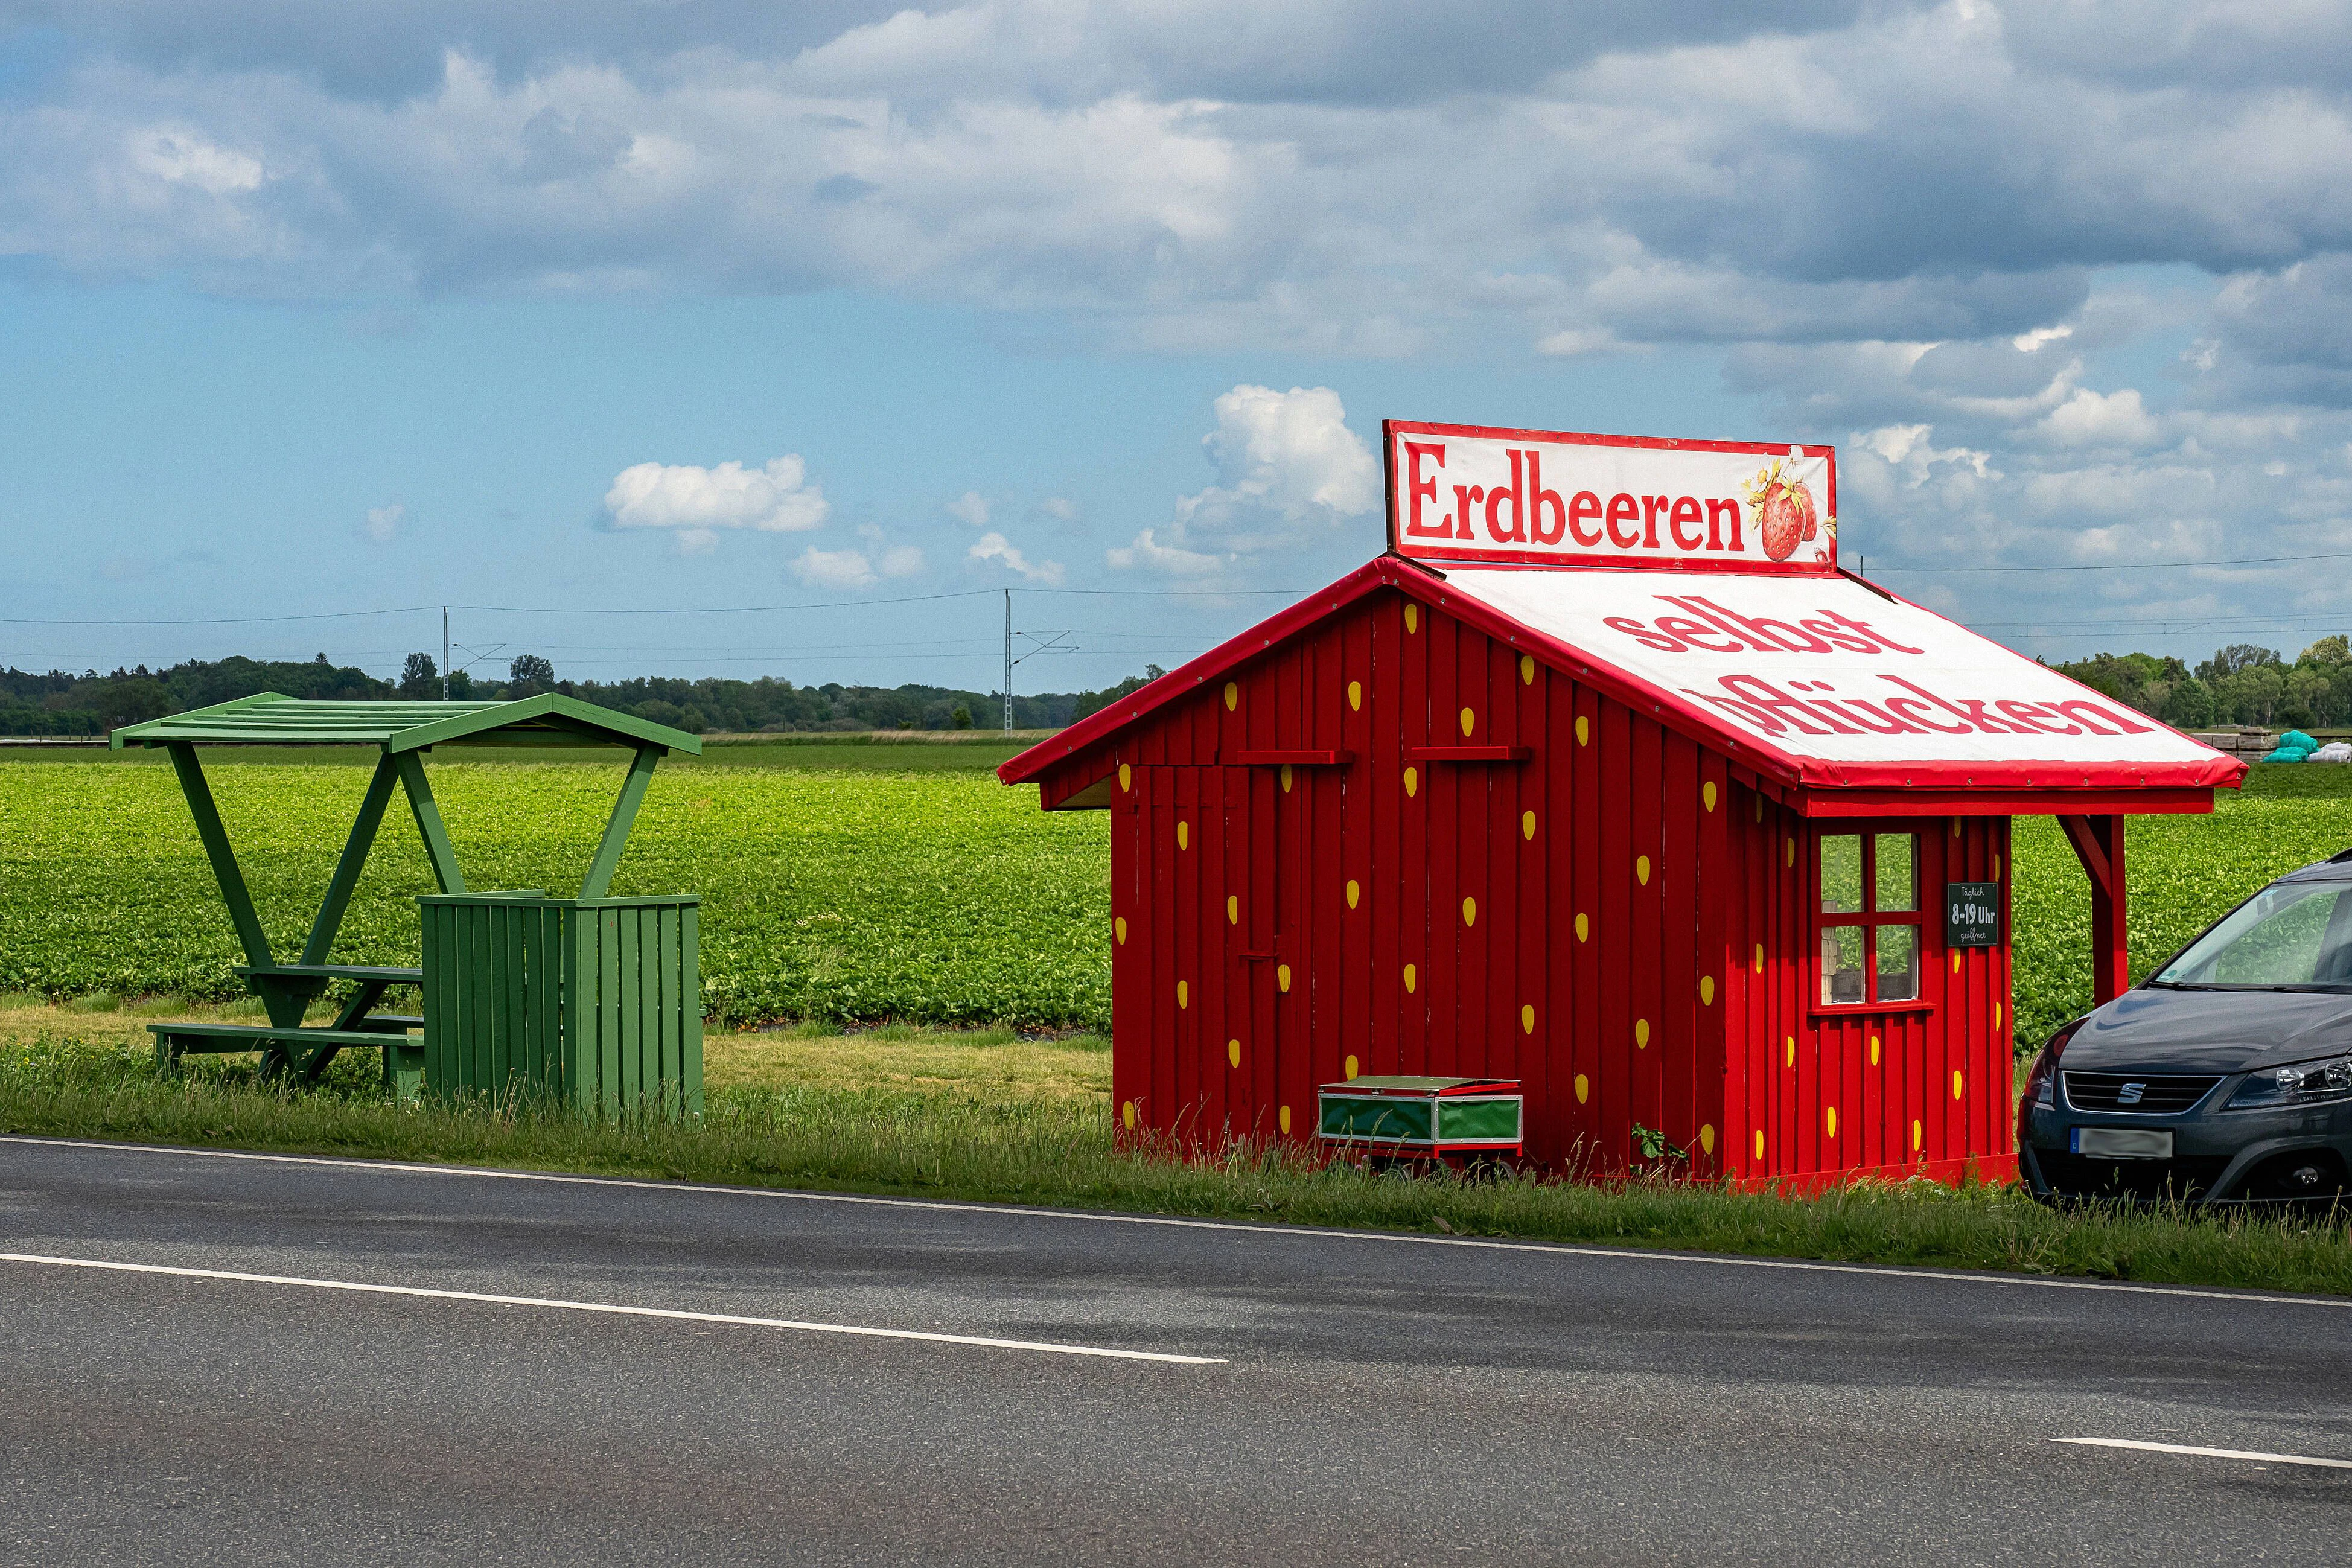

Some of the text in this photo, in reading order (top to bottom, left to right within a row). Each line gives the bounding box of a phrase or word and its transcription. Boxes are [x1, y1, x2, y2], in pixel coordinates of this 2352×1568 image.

[1404, 441, 1745, 552] Erdbeeren
[1603, 595, 1925, 654] selbst
[1677, 675, 2155, 743] pflücken
[1961, 887, 1984, 900] Täglich
[1952, 903, 1995, 925] 8-19 Uhr
[1960, 927, 1986, 943] geöffnet
